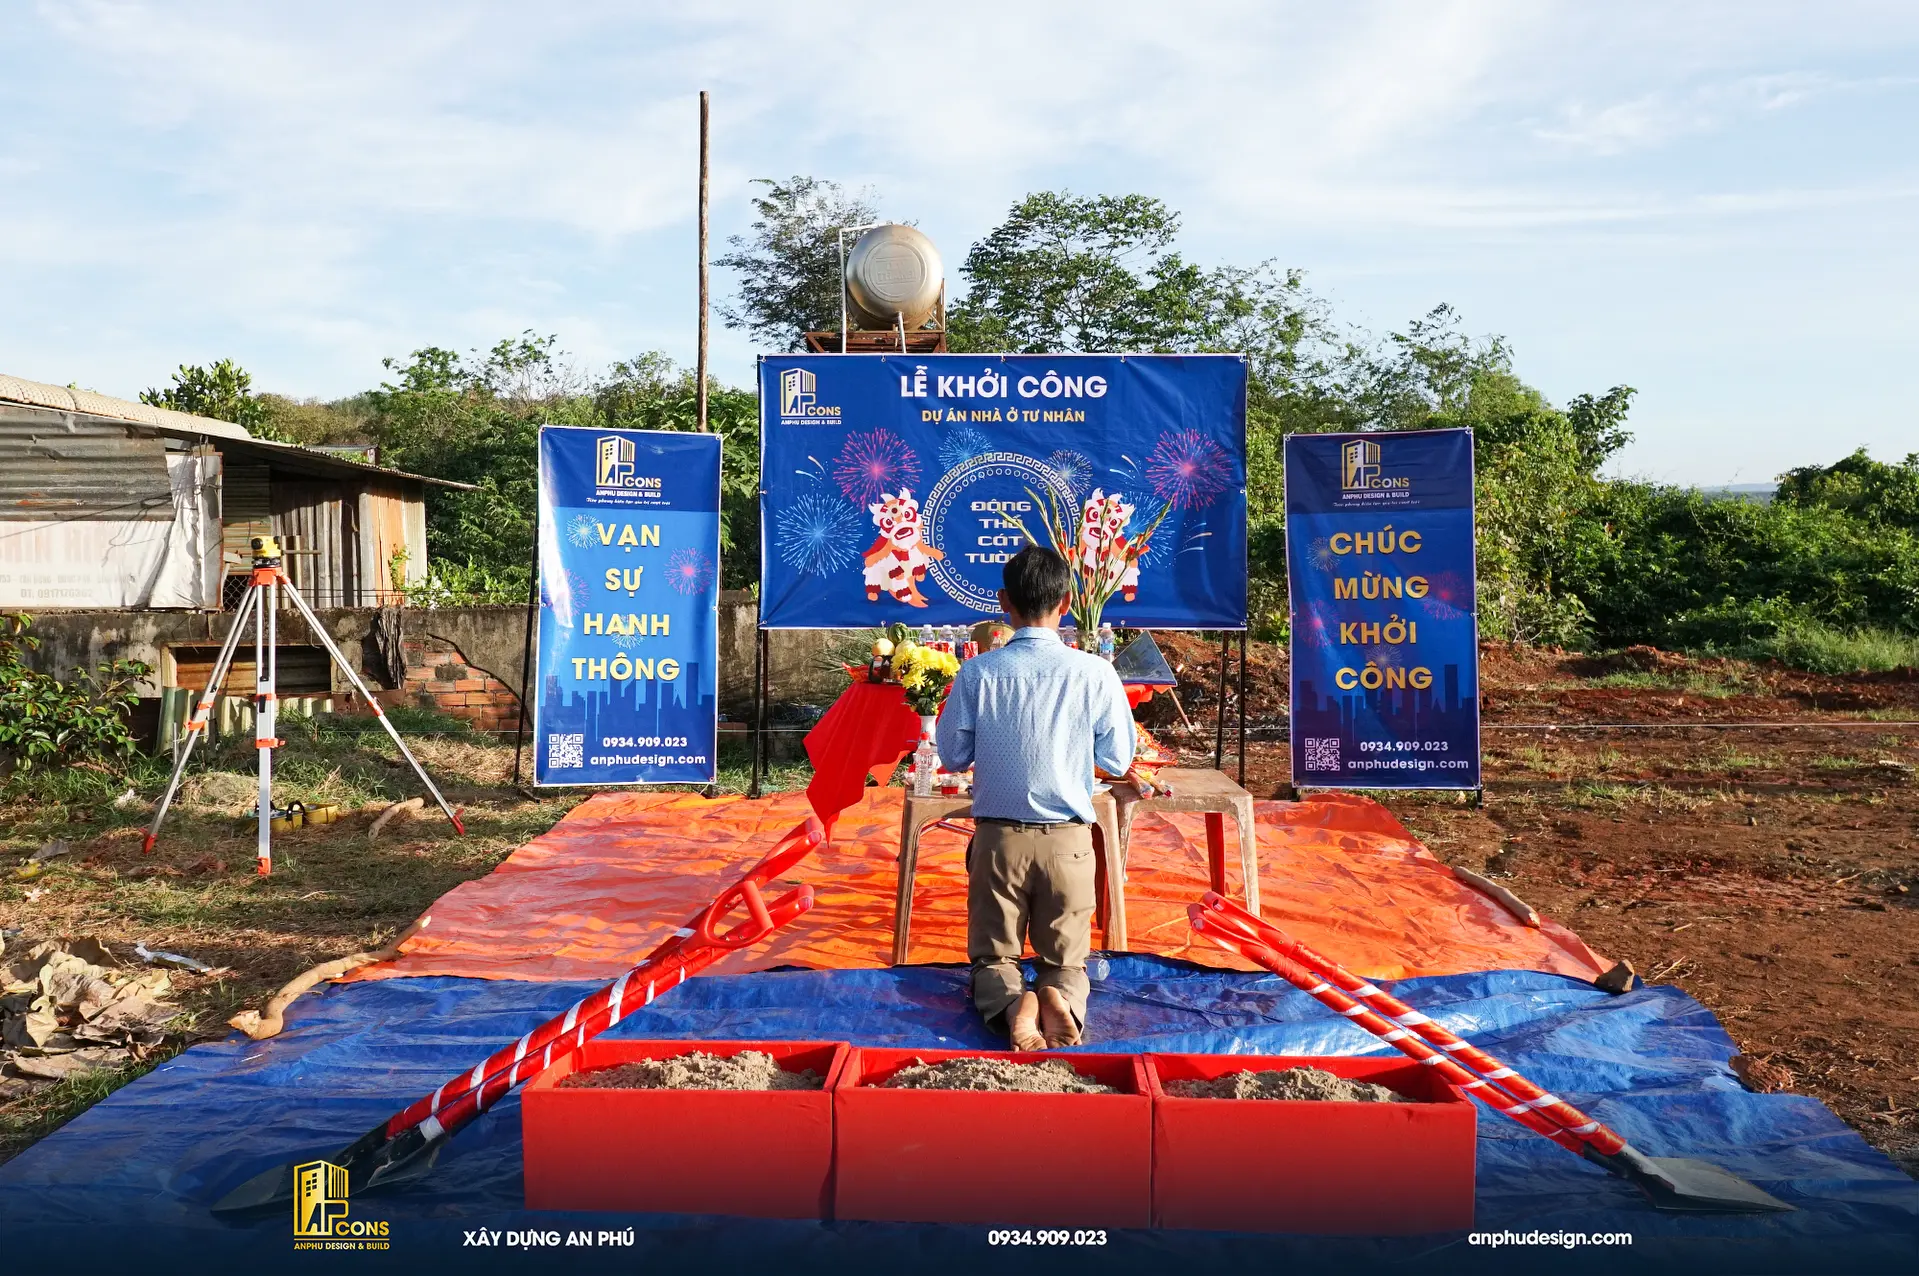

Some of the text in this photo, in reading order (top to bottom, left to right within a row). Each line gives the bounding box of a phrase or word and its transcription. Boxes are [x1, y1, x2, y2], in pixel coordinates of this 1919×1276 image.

[901, 365, 1108, 398] LỄ KHỞI CÔNG
[922, 407, 1085, 424] DỰ ÁN NHÀ Ở TƯ NHÂN
[624, 477, 662, 488] CONS
[1371, 478, 1410, 488] CONS
[596, 524, 661, 553] VẠN
[1329, 524, 1422, 555] CHÚC
[605, 566, 643, 598] SỰ
[1334, 570, 1429, 600] MỪNG
[583, 613, 670, 636] HANH
[1340, 614, 1417, 645] KHỞI
[571, 652, 680, 681] THÔNG
[1335, 661, 1433, 690] CÔNG
[602, 737, 687, 748] 0934.909.023
[1360, 741, 1449, 752] 0934.909.023
[590, 754, 706, 766] anphudesign.com
[1348, 759, 1469, 771] anphudesign.com
